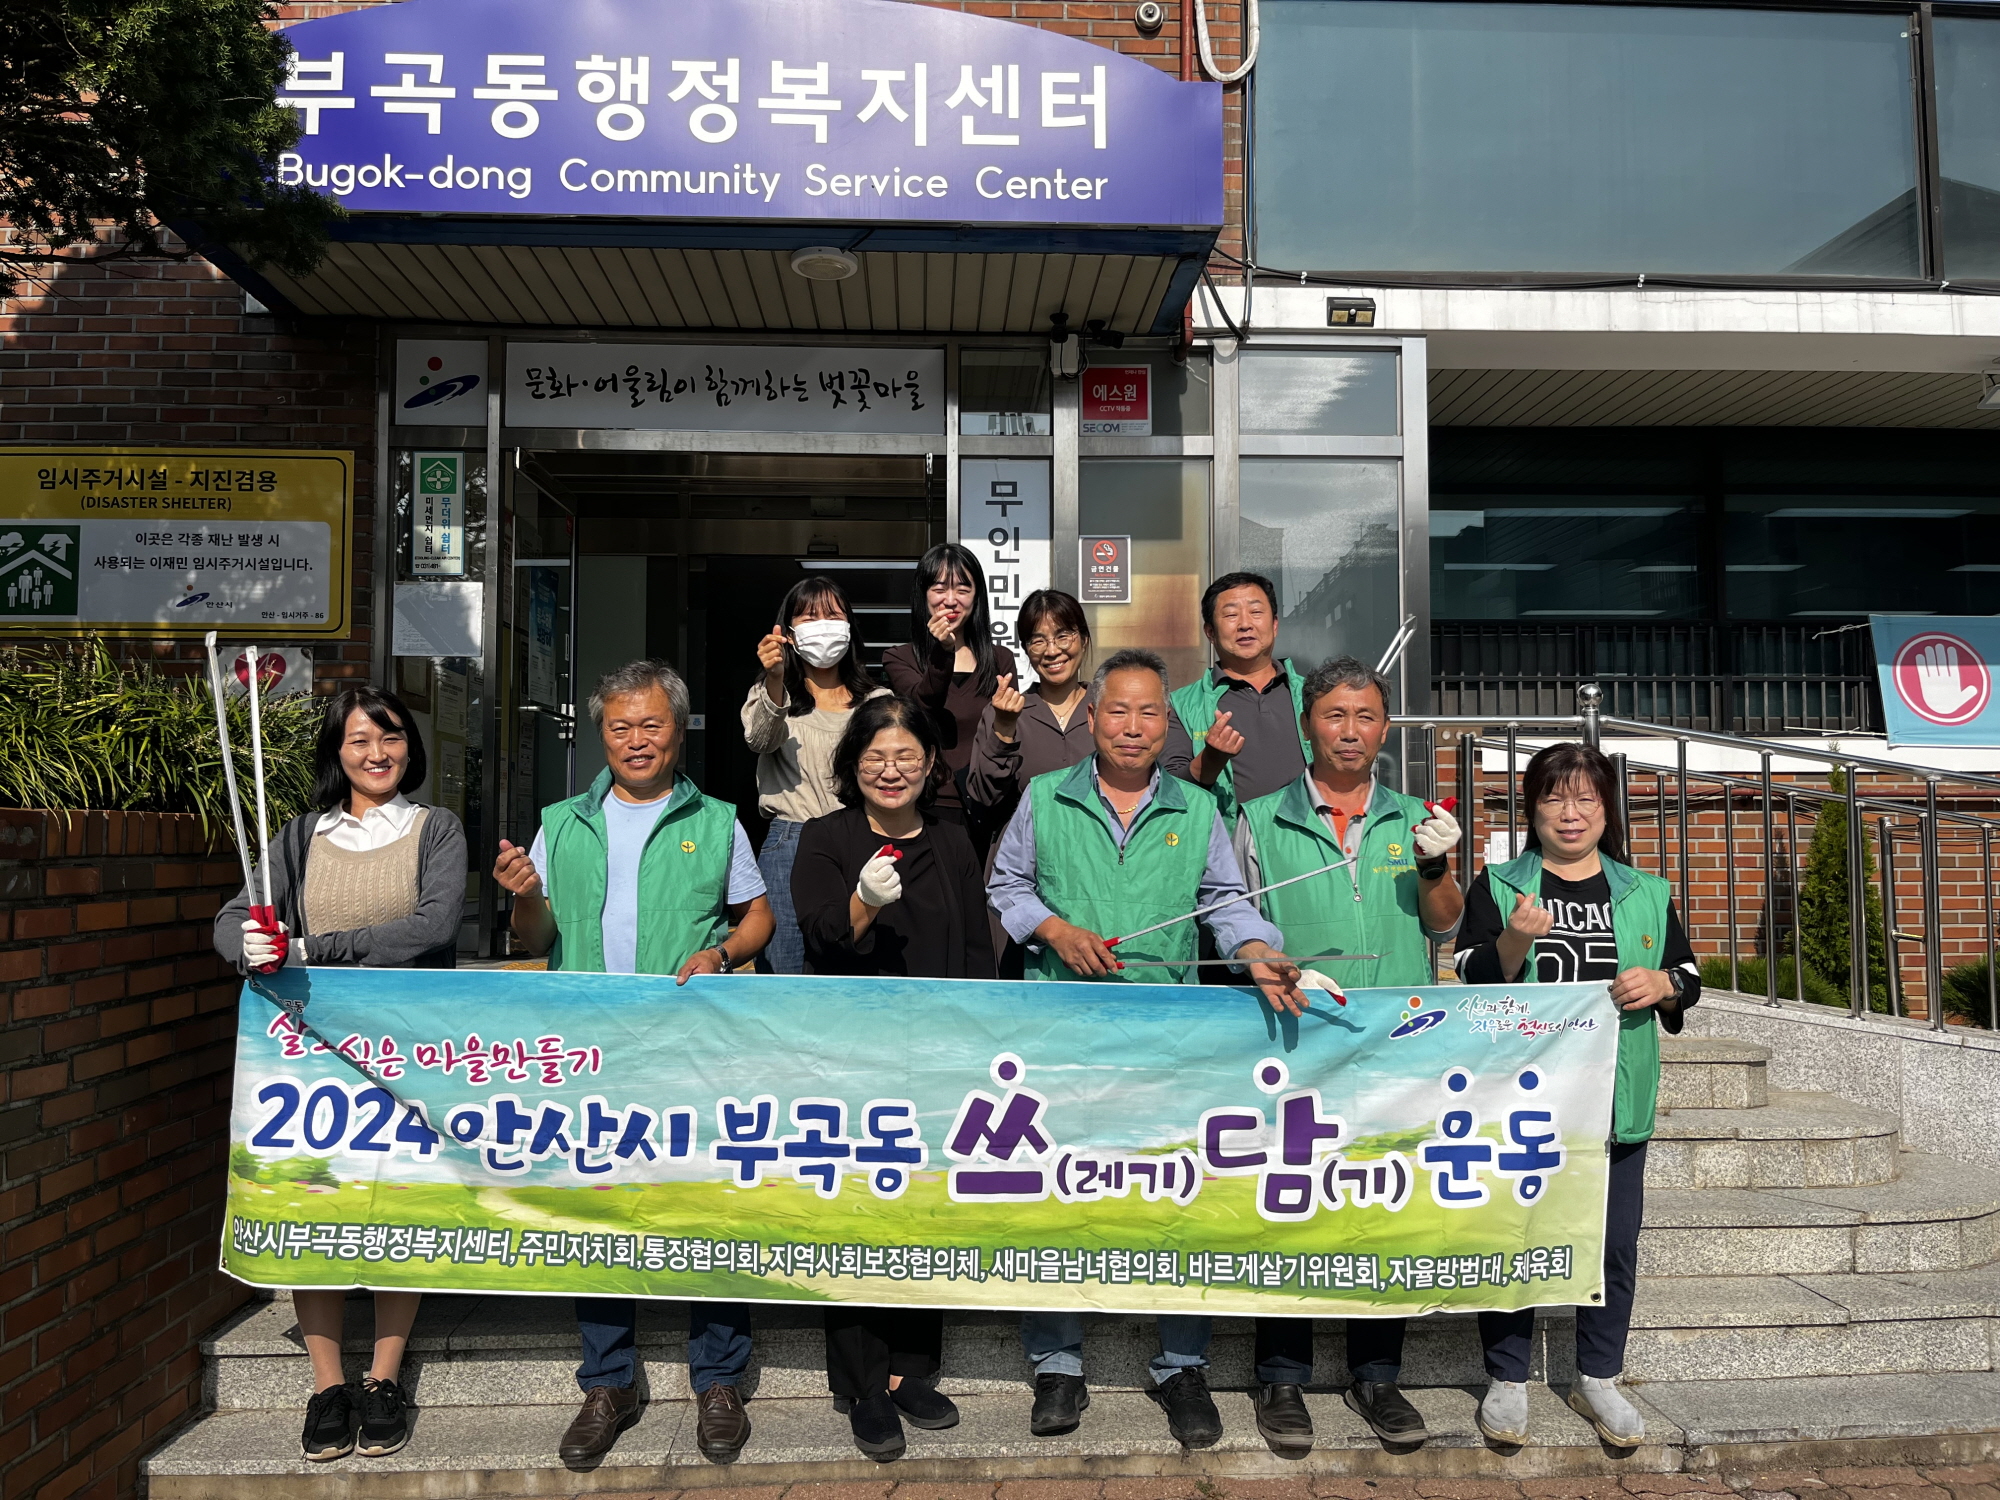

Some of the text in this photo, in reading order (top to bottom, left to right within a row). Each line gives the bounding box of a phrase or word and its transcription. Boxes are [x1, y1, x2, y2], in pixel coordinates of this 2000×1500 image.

[276, 51, 1107, 149] 부곡동행정복지센터
[278, 154, 1108, 203] Bugok-dong Community Service Center
[1092, 384, 1137, 402] 에스원
[1083, 423, 1120, 433] SECOM
[37, 468, 168, 490] 임시주거시설
[190, 469, 278, 492] 지진겸용
[80, 495, 232, 512] (DISASTER SHELTER)
[135, 532, 280, 547] 이곳은 각종 재난 발생 시
[424, 497, 433, 554] 미세먼지 쉼터
[441, 497, 451, 554] 무더위 쉼터
[94, 556, 313, 571] 사용되는 이재민 임시주거시설입니다.
[984, 481, 1023, 680] 무인민원
[205, 601, 233, 609] 안산시
[251, 1082, 439, 1156] 2024
[450, 1099, 691, 1171] 안산시
[715, 1101, 922, 1193] 부곡동
[1424, 1100, 1561, 1201] 운동
[1511, 1246, 1572, 1285] 체육회
